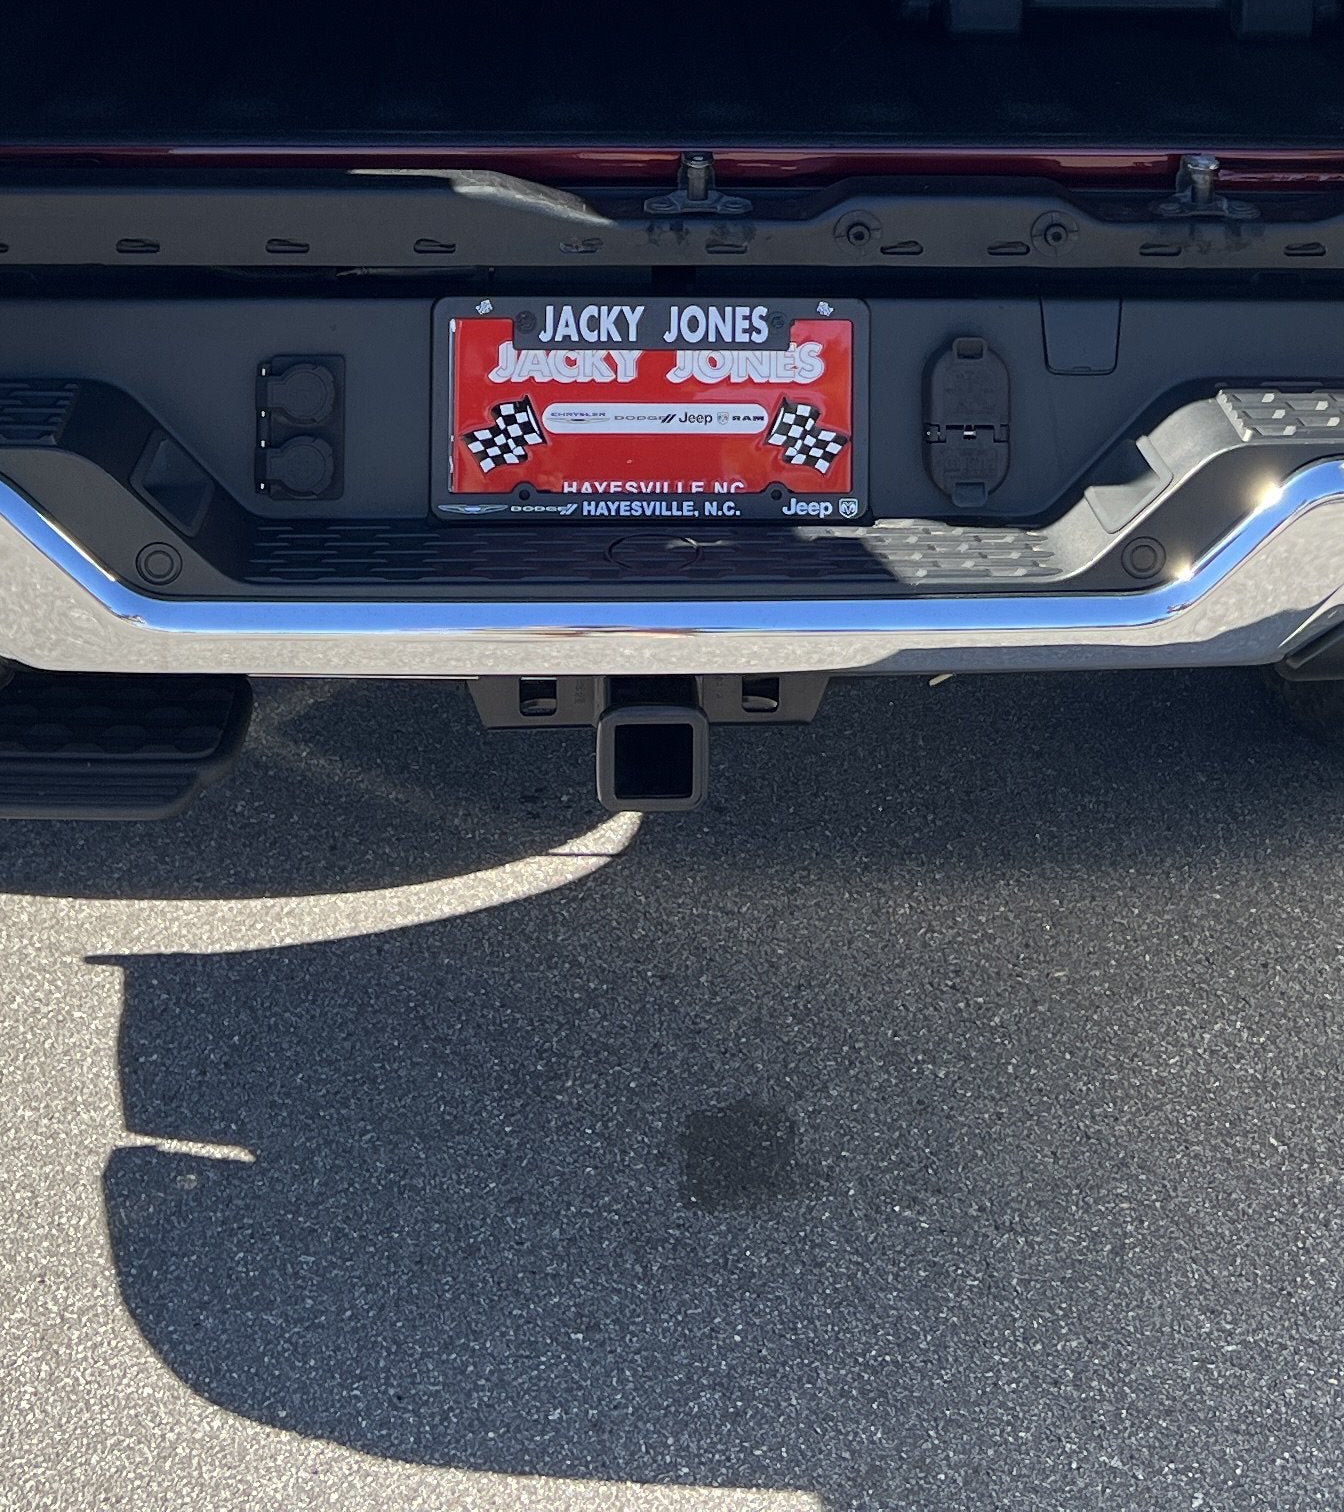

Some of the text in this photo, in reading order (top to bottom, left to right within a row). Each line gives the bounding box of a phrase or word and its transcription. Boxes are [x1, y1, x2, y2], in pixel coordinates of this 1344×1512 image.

[538, 304, 769, 344] JACKY JONES
[487, 340, 826, 384] JACKY JONES
[678, 411, 714, 426] Jeep
[731, 414, 765, 422] RAM
[582, 500, 699, 518] HAYESVILLE,
[704, 500, 741, 517] N.C.
[781, 497, 833, 519] Jeep
